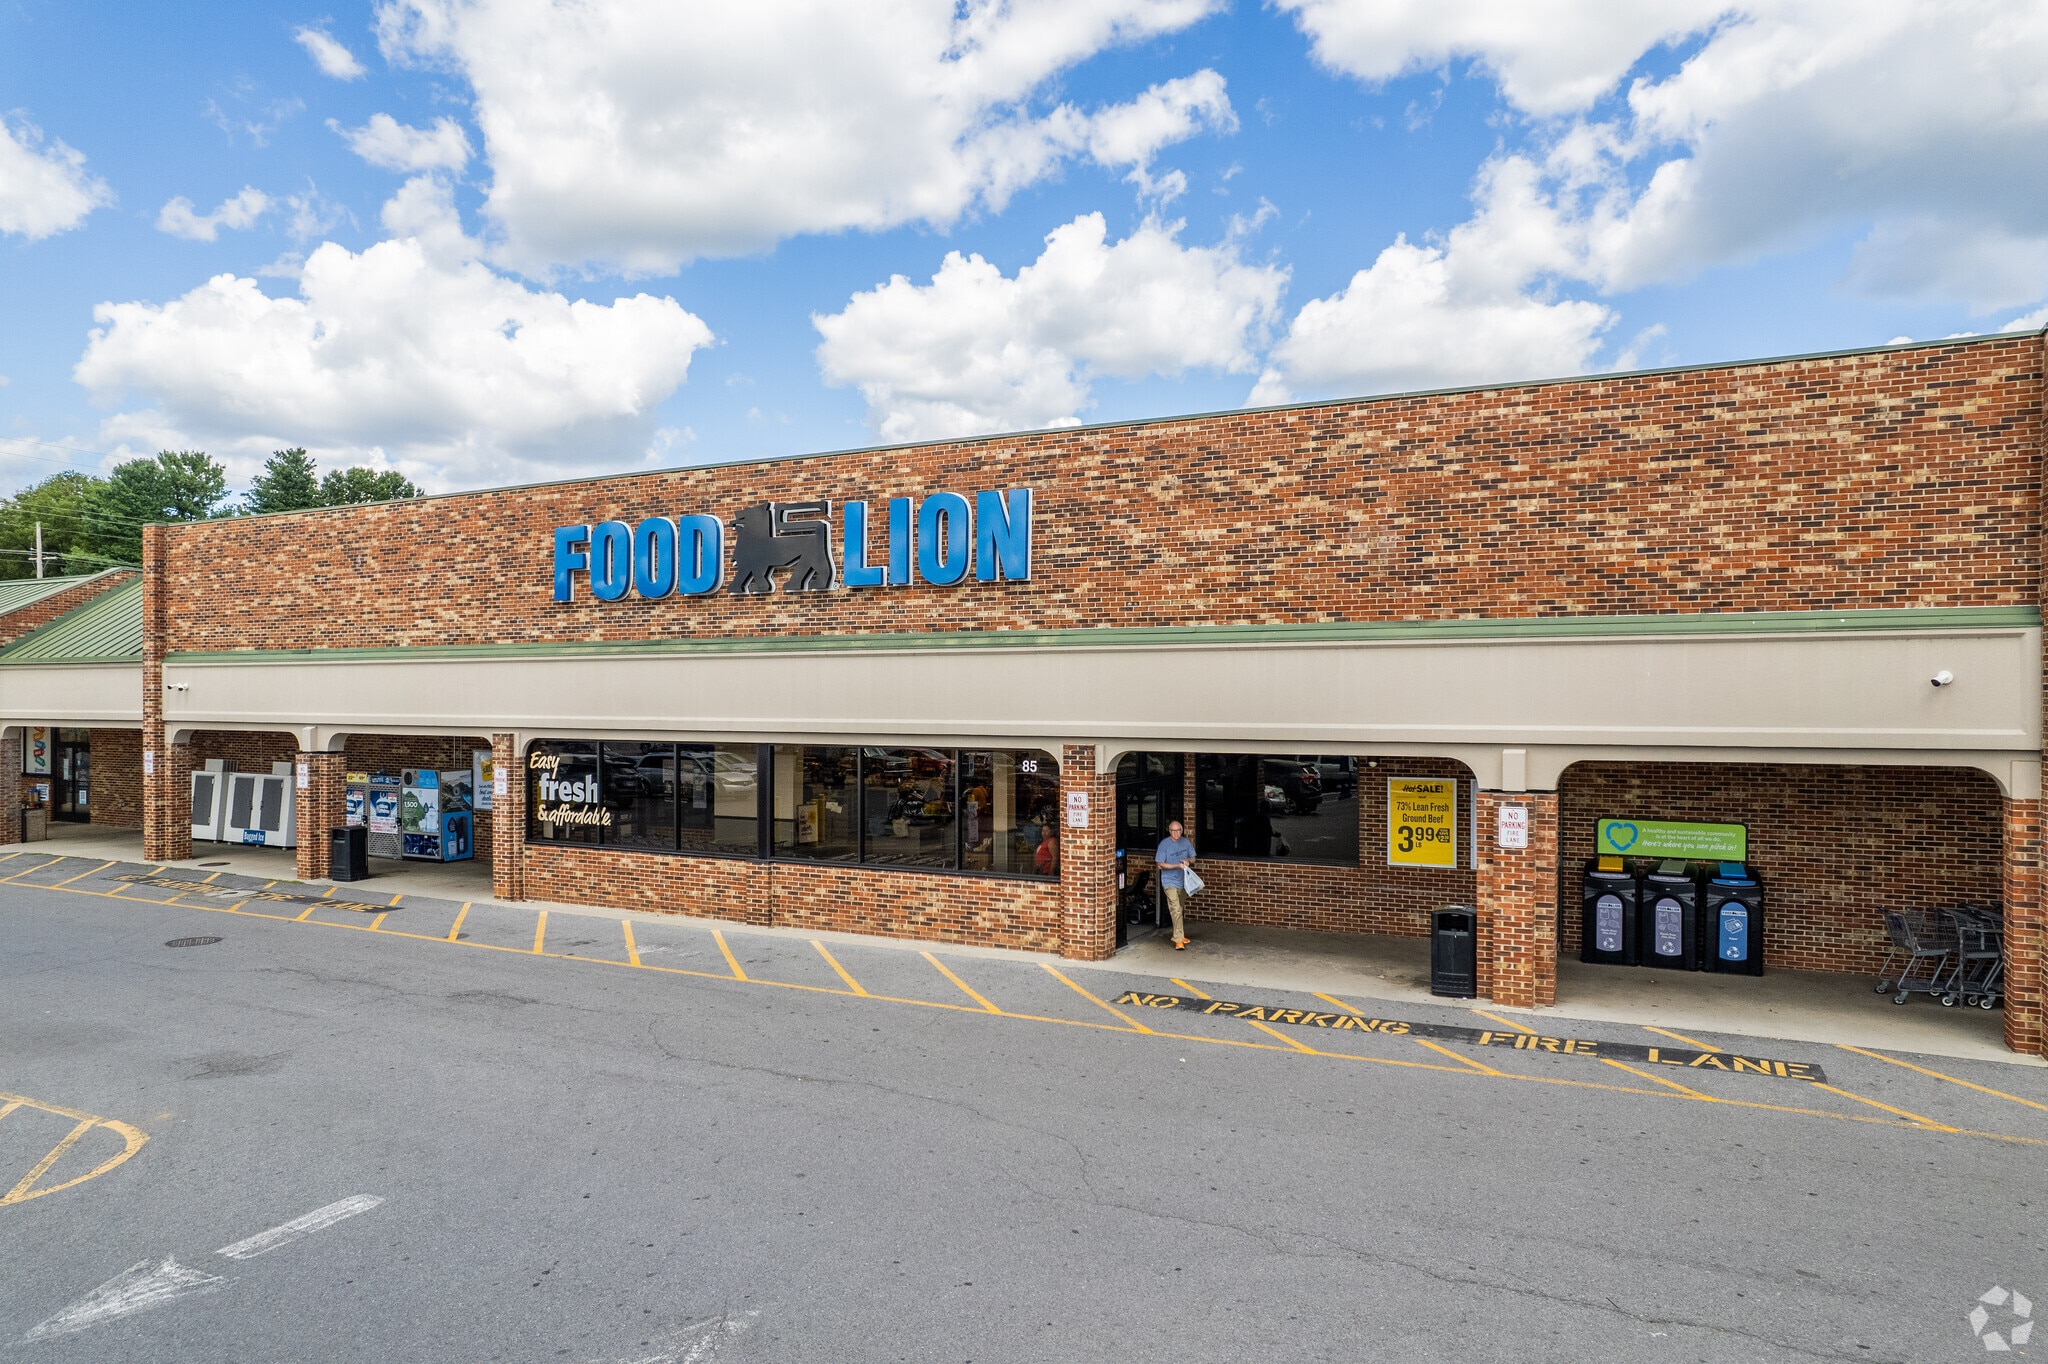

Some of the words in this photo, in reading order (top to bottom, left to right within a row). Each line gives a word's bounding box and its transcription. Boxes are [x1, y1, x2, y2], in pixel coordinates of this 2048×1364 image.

[554, 514, 724, 602] FOOD
[843, 488, 1034, 587] LION
[530, 752, 560, 779] Easy
[1022, 760, 1037, 772] 85
[539, 773, 598, 803] fresh
[1402, 784, 1417, 793] Hot
[1416, 784, 1443, 793] SALE!
[1397, 801, 1411, 811] 73%
[1412, 802, 1428, 812] Lean
[1430, 802, 1449, 812] Fresh
[1402, 813, 1426, 823] Ground
[1428, 814, 1444, 823] Beef
[1508, 812, 1518, 820] NO
[1502, 821, 1526, 830] PARKING
[1682, 843, 1694, 851] you
[1709, 843, 1726, 851] pitch
[1117, 992, 1180, 1009] NO
[1204, 1001, 1411, 1035] PARKING
[1478, 1031, 1598, 1056] FIRE
[1648, 1049, 1815, 1080] LANE
